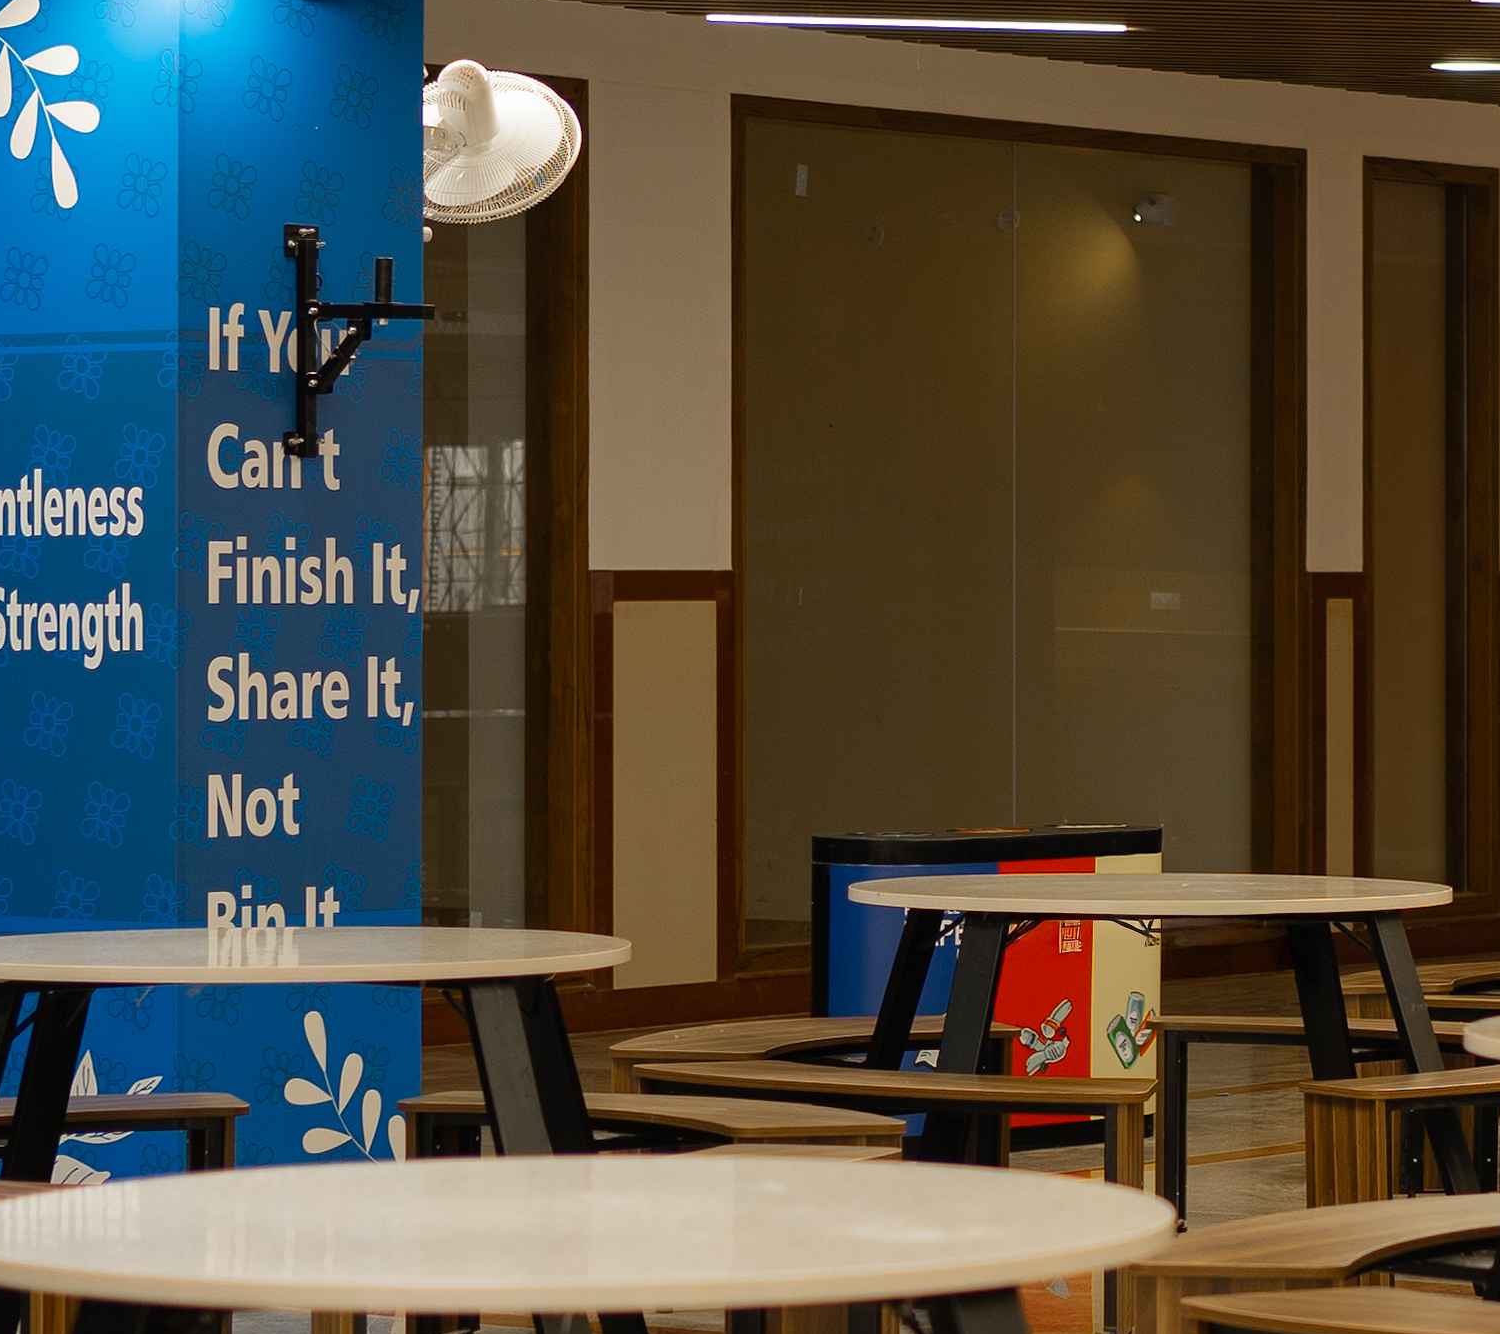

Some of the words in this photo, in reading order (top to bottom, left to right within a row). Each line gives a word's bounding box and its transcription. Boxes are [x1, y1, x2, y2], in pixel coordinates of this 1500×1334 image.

[208, 302, 245, 372] If
[207, 535, 355, 606] Finish
[372, 542, 421, 615] It,
[206, 652, 350, 723] Share
[366, 655, 415, 727] It,
[207, 772, 301, 839] Not
